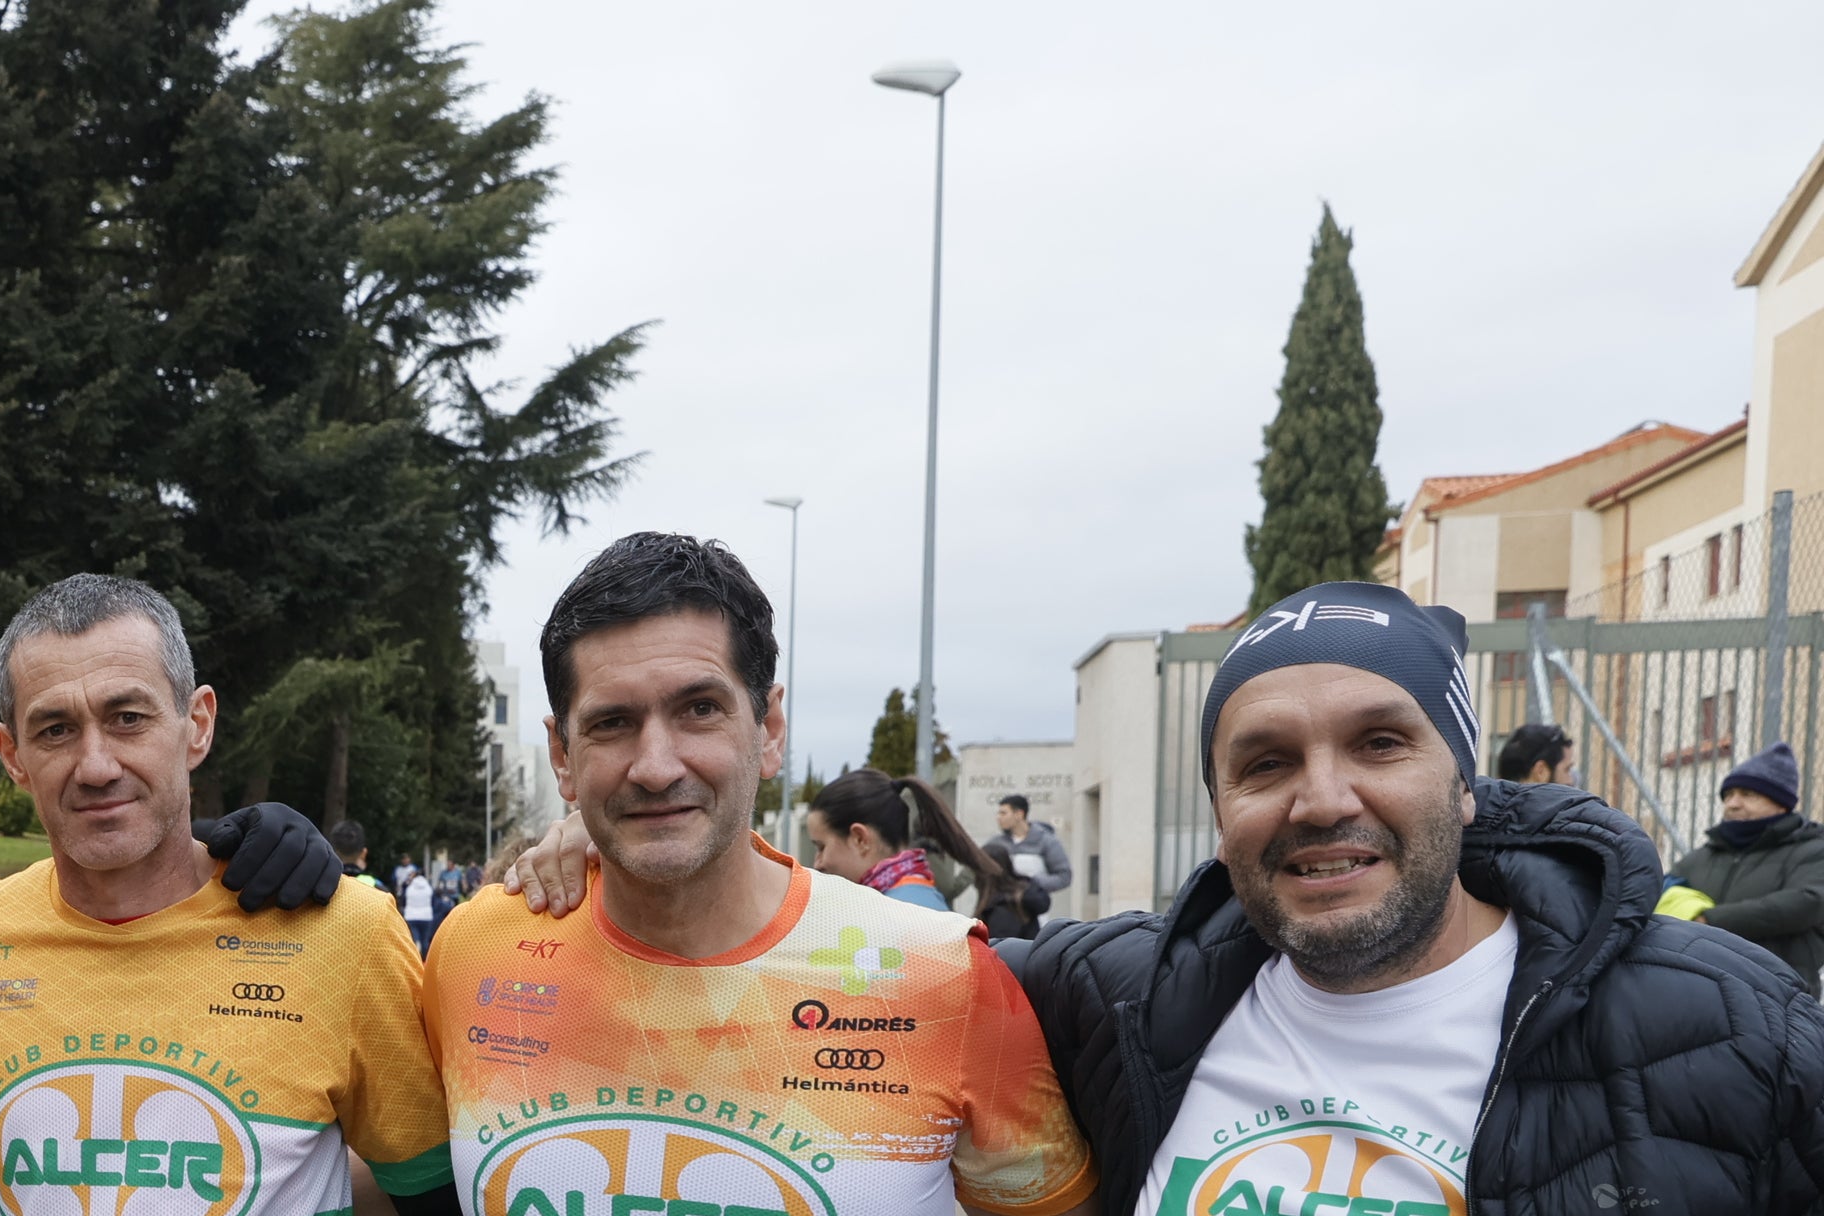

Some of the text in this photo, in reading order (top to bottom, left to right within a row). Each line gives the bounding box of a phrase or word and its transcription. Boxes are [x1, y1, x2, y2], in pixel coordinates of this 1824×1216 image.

[242, 940, 304, 952] consulting
[516, 939, 564, 959] EKT
[209, 1003, 303, 1023] Helmántica
[826, 1016, 916, 1032] ANDRÉS
[489, 1033, 550, 1054] consulting
[63, 1033, 260, 1108] DEPORTIVO
[782, 1076, 909, 1094] Helmántica
[478, 1086, 835, 1173] CLUB DEPORTIVO
[1213, 1104, 1290, 1144] CLUB
[3, 1137, 224, 1203] ALCER
